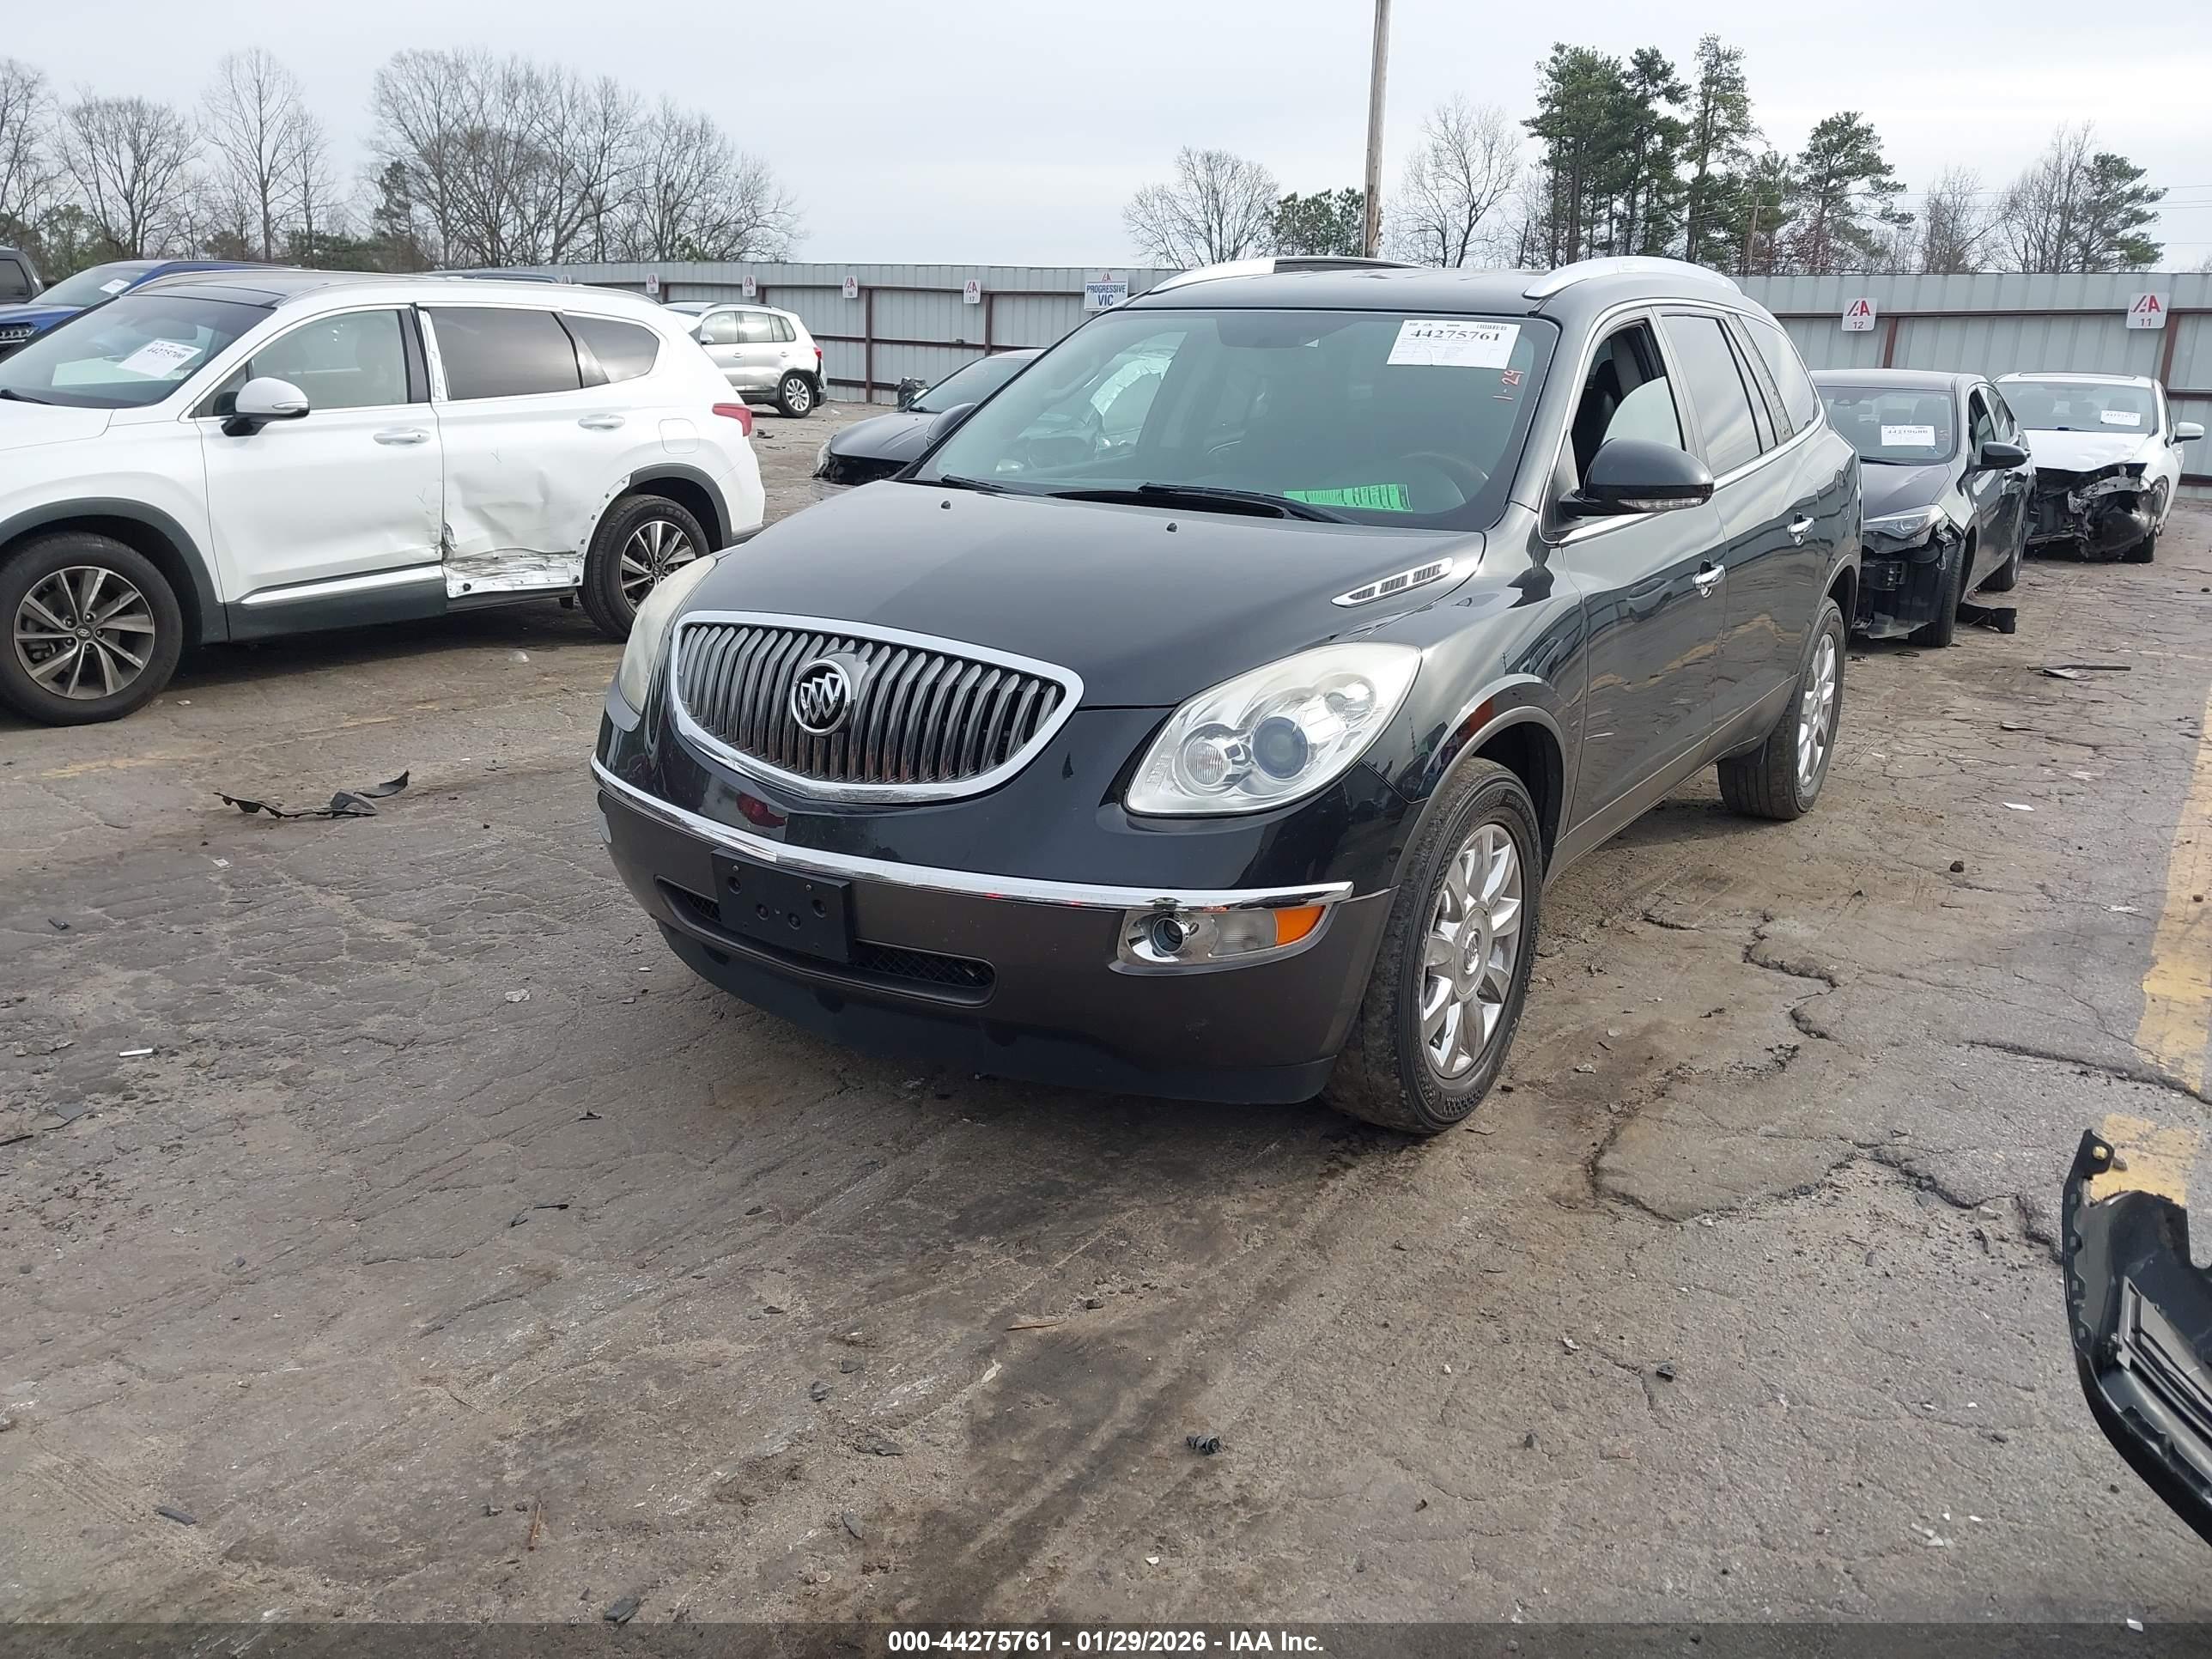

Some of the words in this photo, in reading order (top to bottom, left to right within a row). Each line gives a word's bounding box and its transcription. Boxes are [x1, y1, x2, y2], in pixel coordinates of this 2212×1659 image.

[1086, 284, 1127, 294] PROGRESSIVE
[1098, 294, 1114, 307] VIC
[1852, 321, 1864, 330] 12
[2140, 318, 2153, 327] 11
[1410, 329, 1500, 342] 44275761
